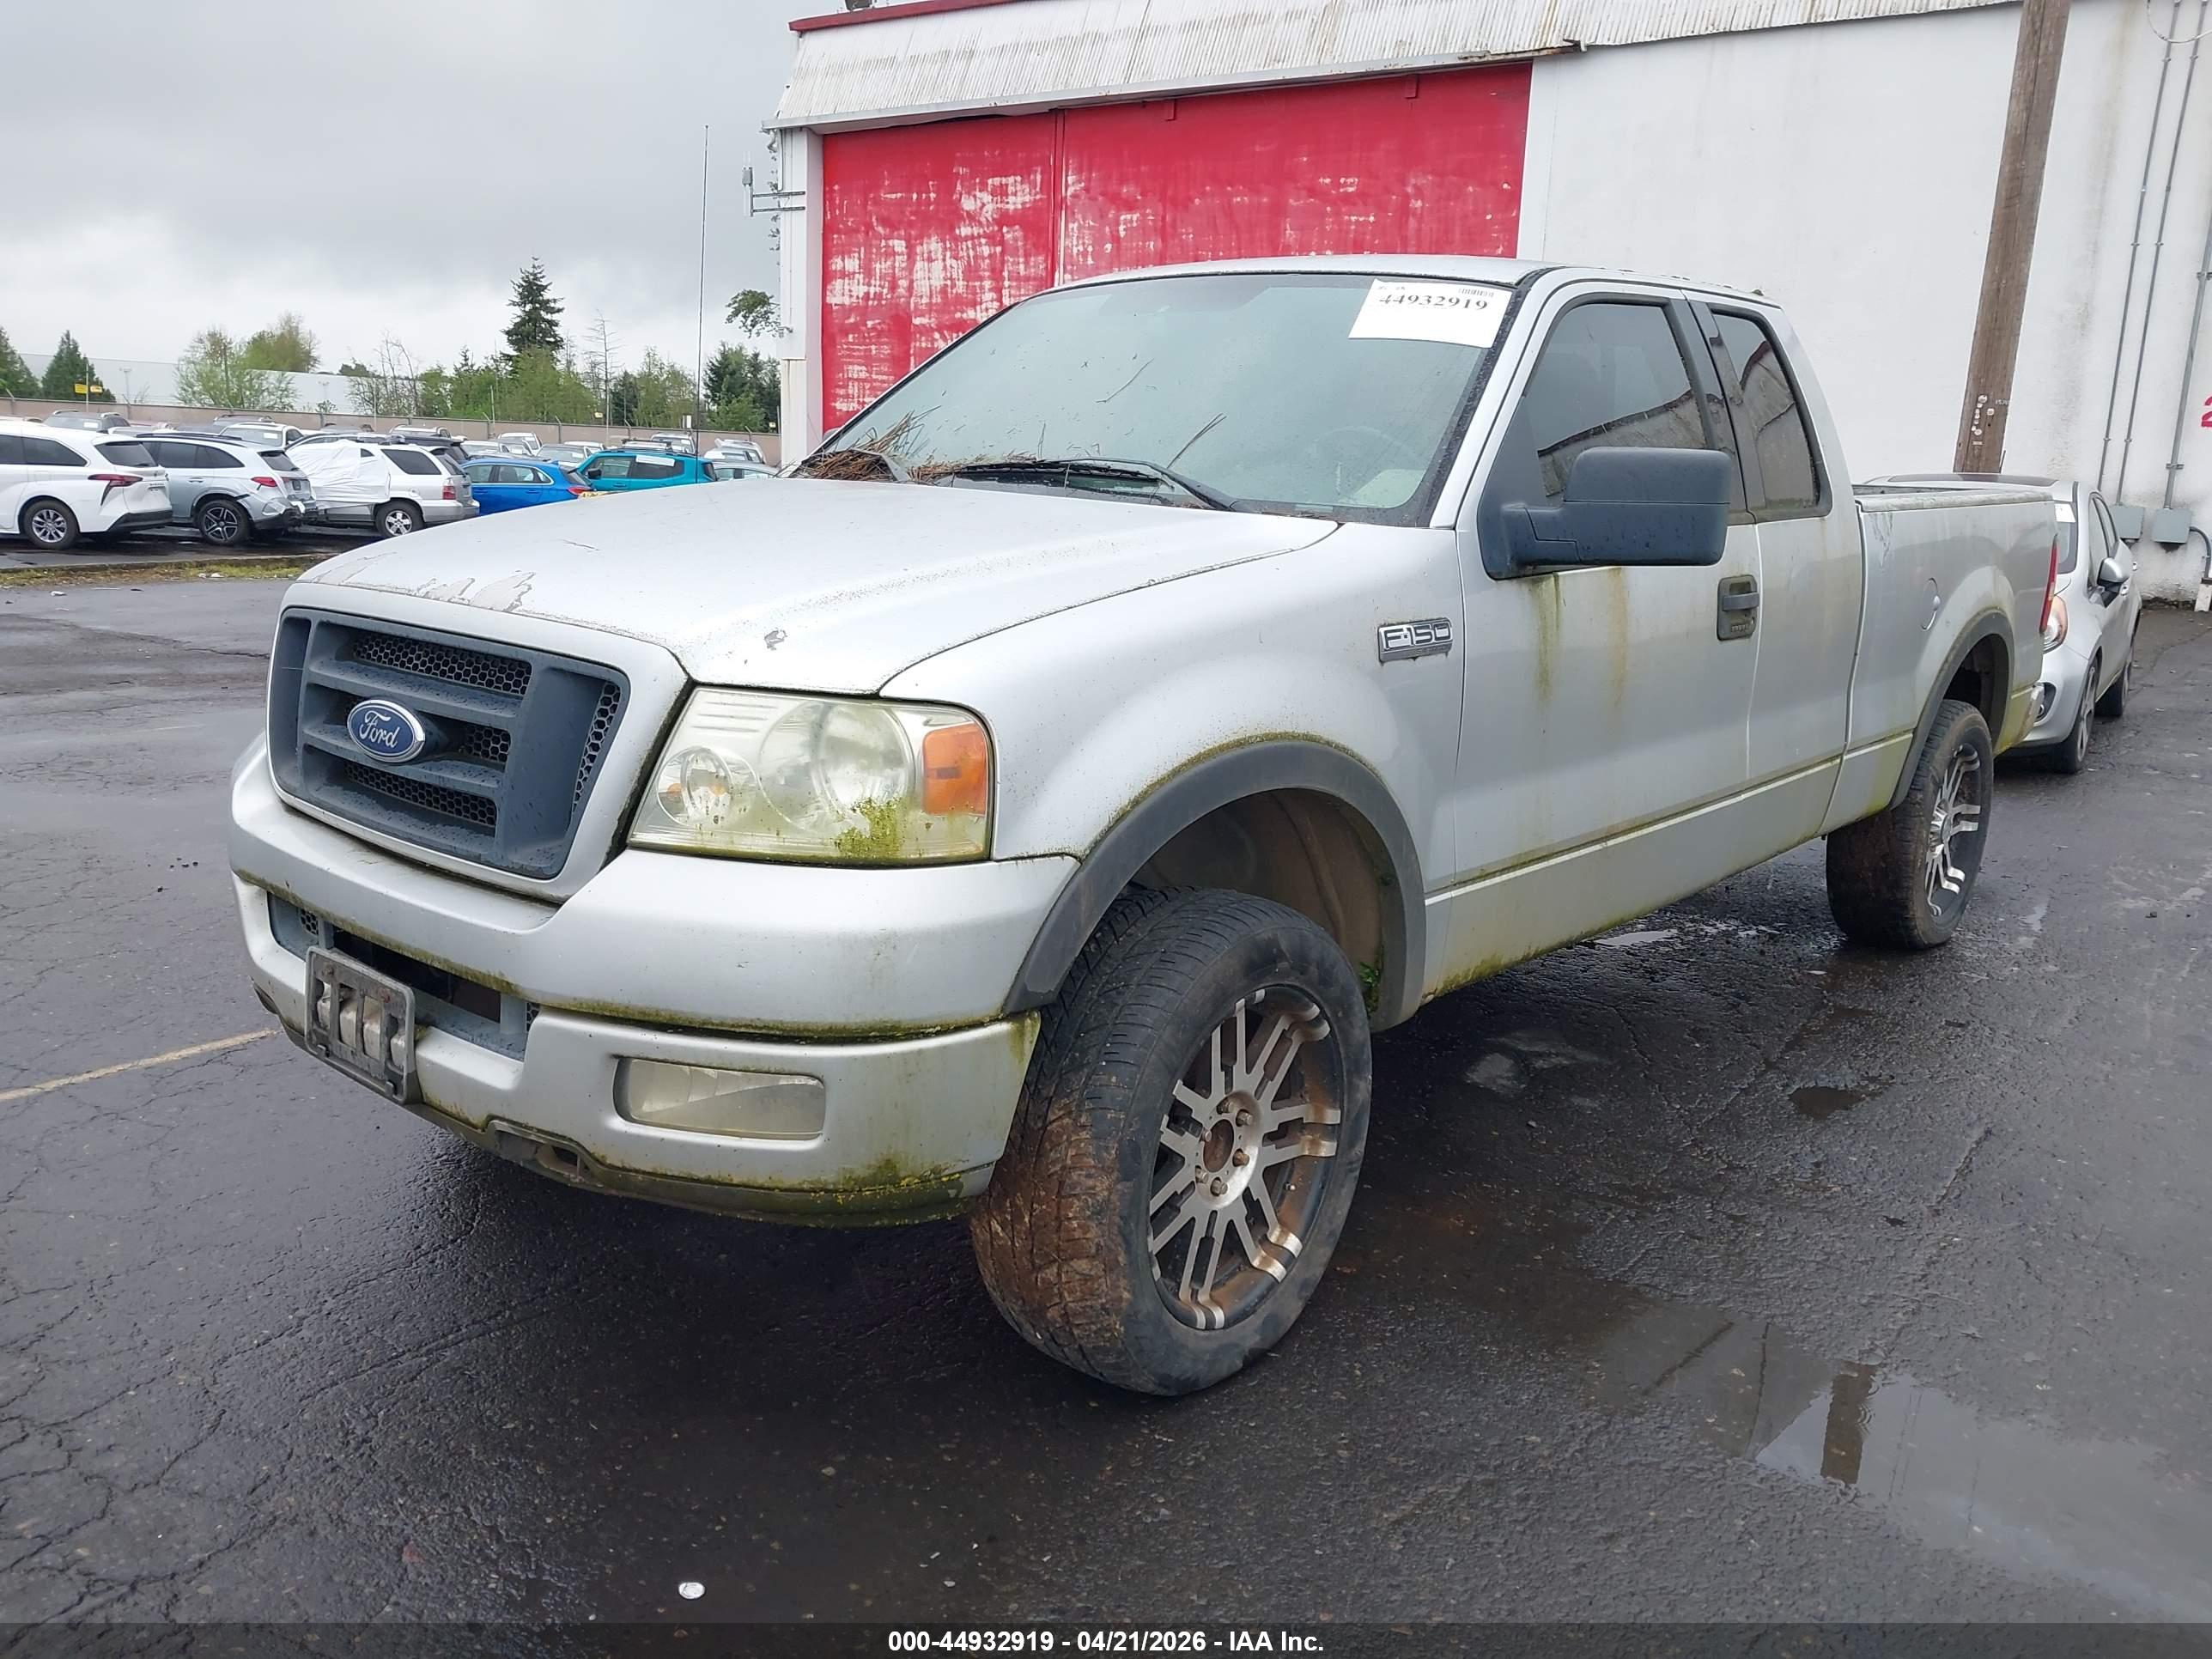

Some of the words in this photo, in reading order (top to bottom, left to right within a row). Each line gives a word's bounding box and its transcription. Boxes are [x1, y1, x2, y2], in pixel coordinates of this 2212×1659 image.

[1379, 294, 1488, 310] 44932919
[1383, 622, 1451, 649] F-150
[359, 710, 400, 748] Ford
